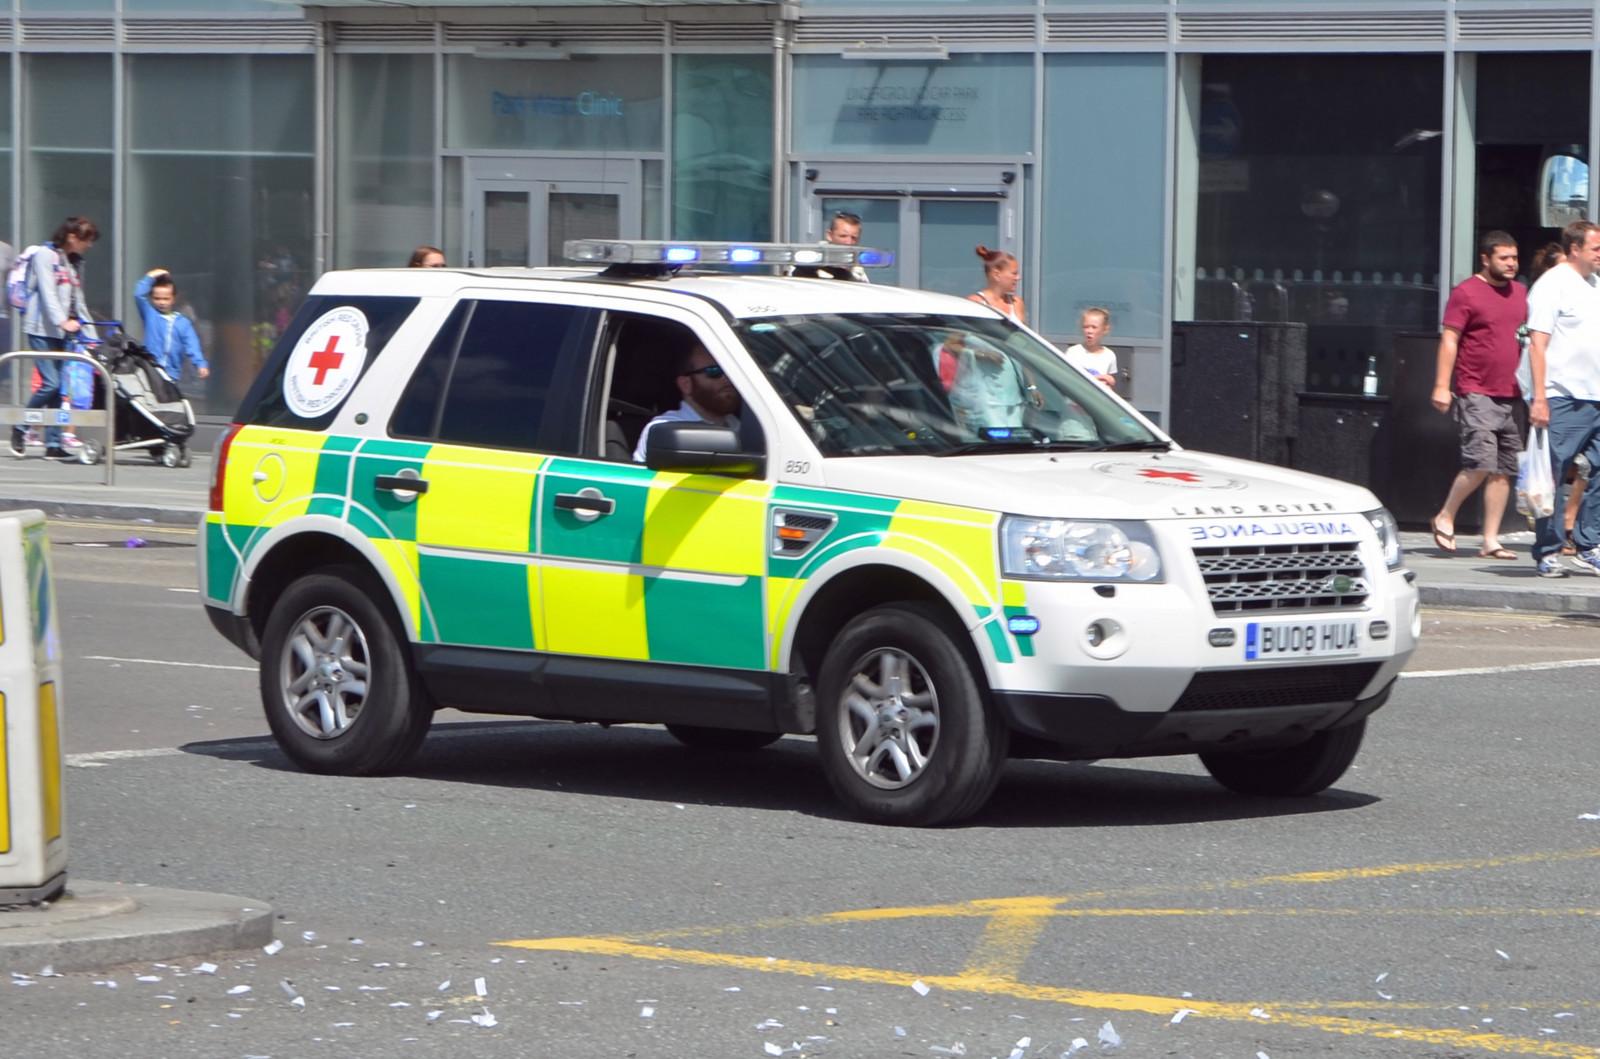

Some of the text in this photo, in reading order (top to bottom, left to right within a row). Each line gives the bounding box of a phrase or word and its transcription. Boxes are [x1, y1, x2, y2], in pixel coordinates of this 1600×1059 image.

[847, 86, 980, 101] UNDERGROUND CAR PARK
[577, 91, 624, 115] Clinic
[785, 460, 810, 475] 850
[1172, 502, 1336, 516] LAND ROVER
[1262, 623, 1358, 653] BU08 HUA
